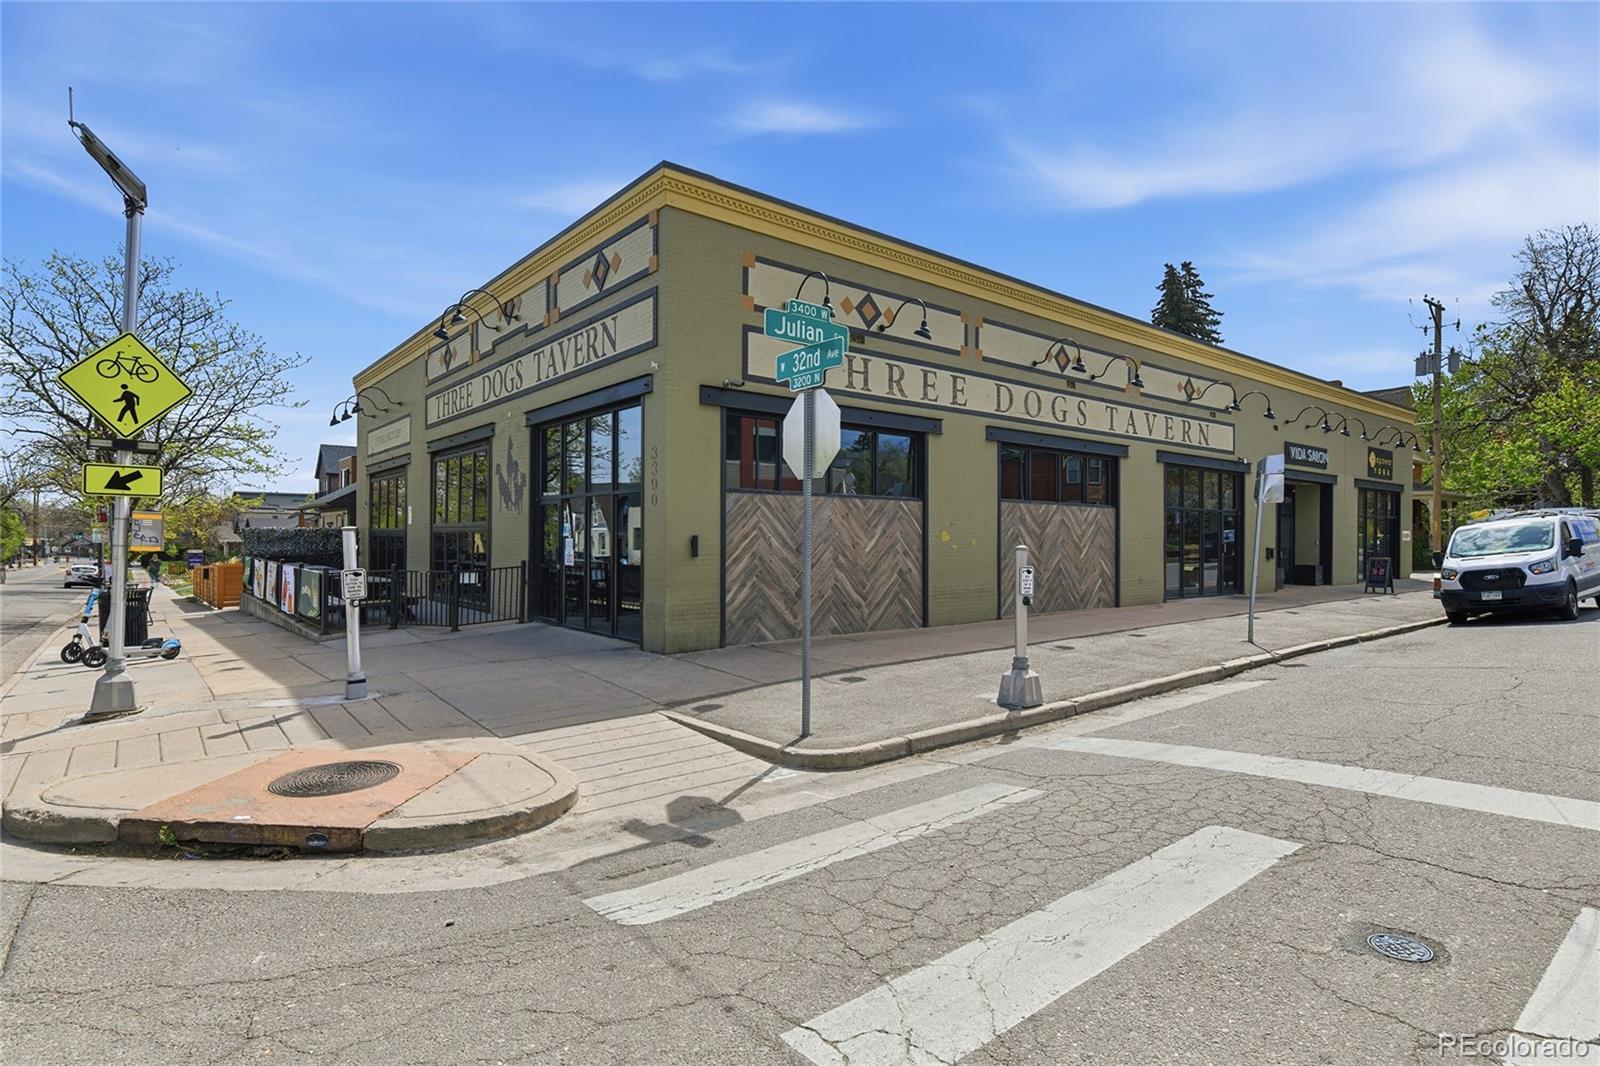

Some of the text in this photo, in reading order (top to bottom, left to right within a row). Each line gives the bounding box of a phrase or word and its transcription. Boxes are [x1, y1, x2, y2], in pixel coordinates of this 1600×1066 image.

[791, 302, 828, 320] 3400 W
[774, 316, 824, 342] Julian
[434, 315, 620, 420] THREE DOGS TAVERN
[792, 347, 820, 372] 32nd
[826, 348, 839, 360] Ave
[793, 373, 820, 388] 3200 N
[844, 353, 1211, 447] HREE DOGS TAVERN
[1290, 446, 1329, 464] VIDA SALON
[650, 444, 658, 506] 3390
